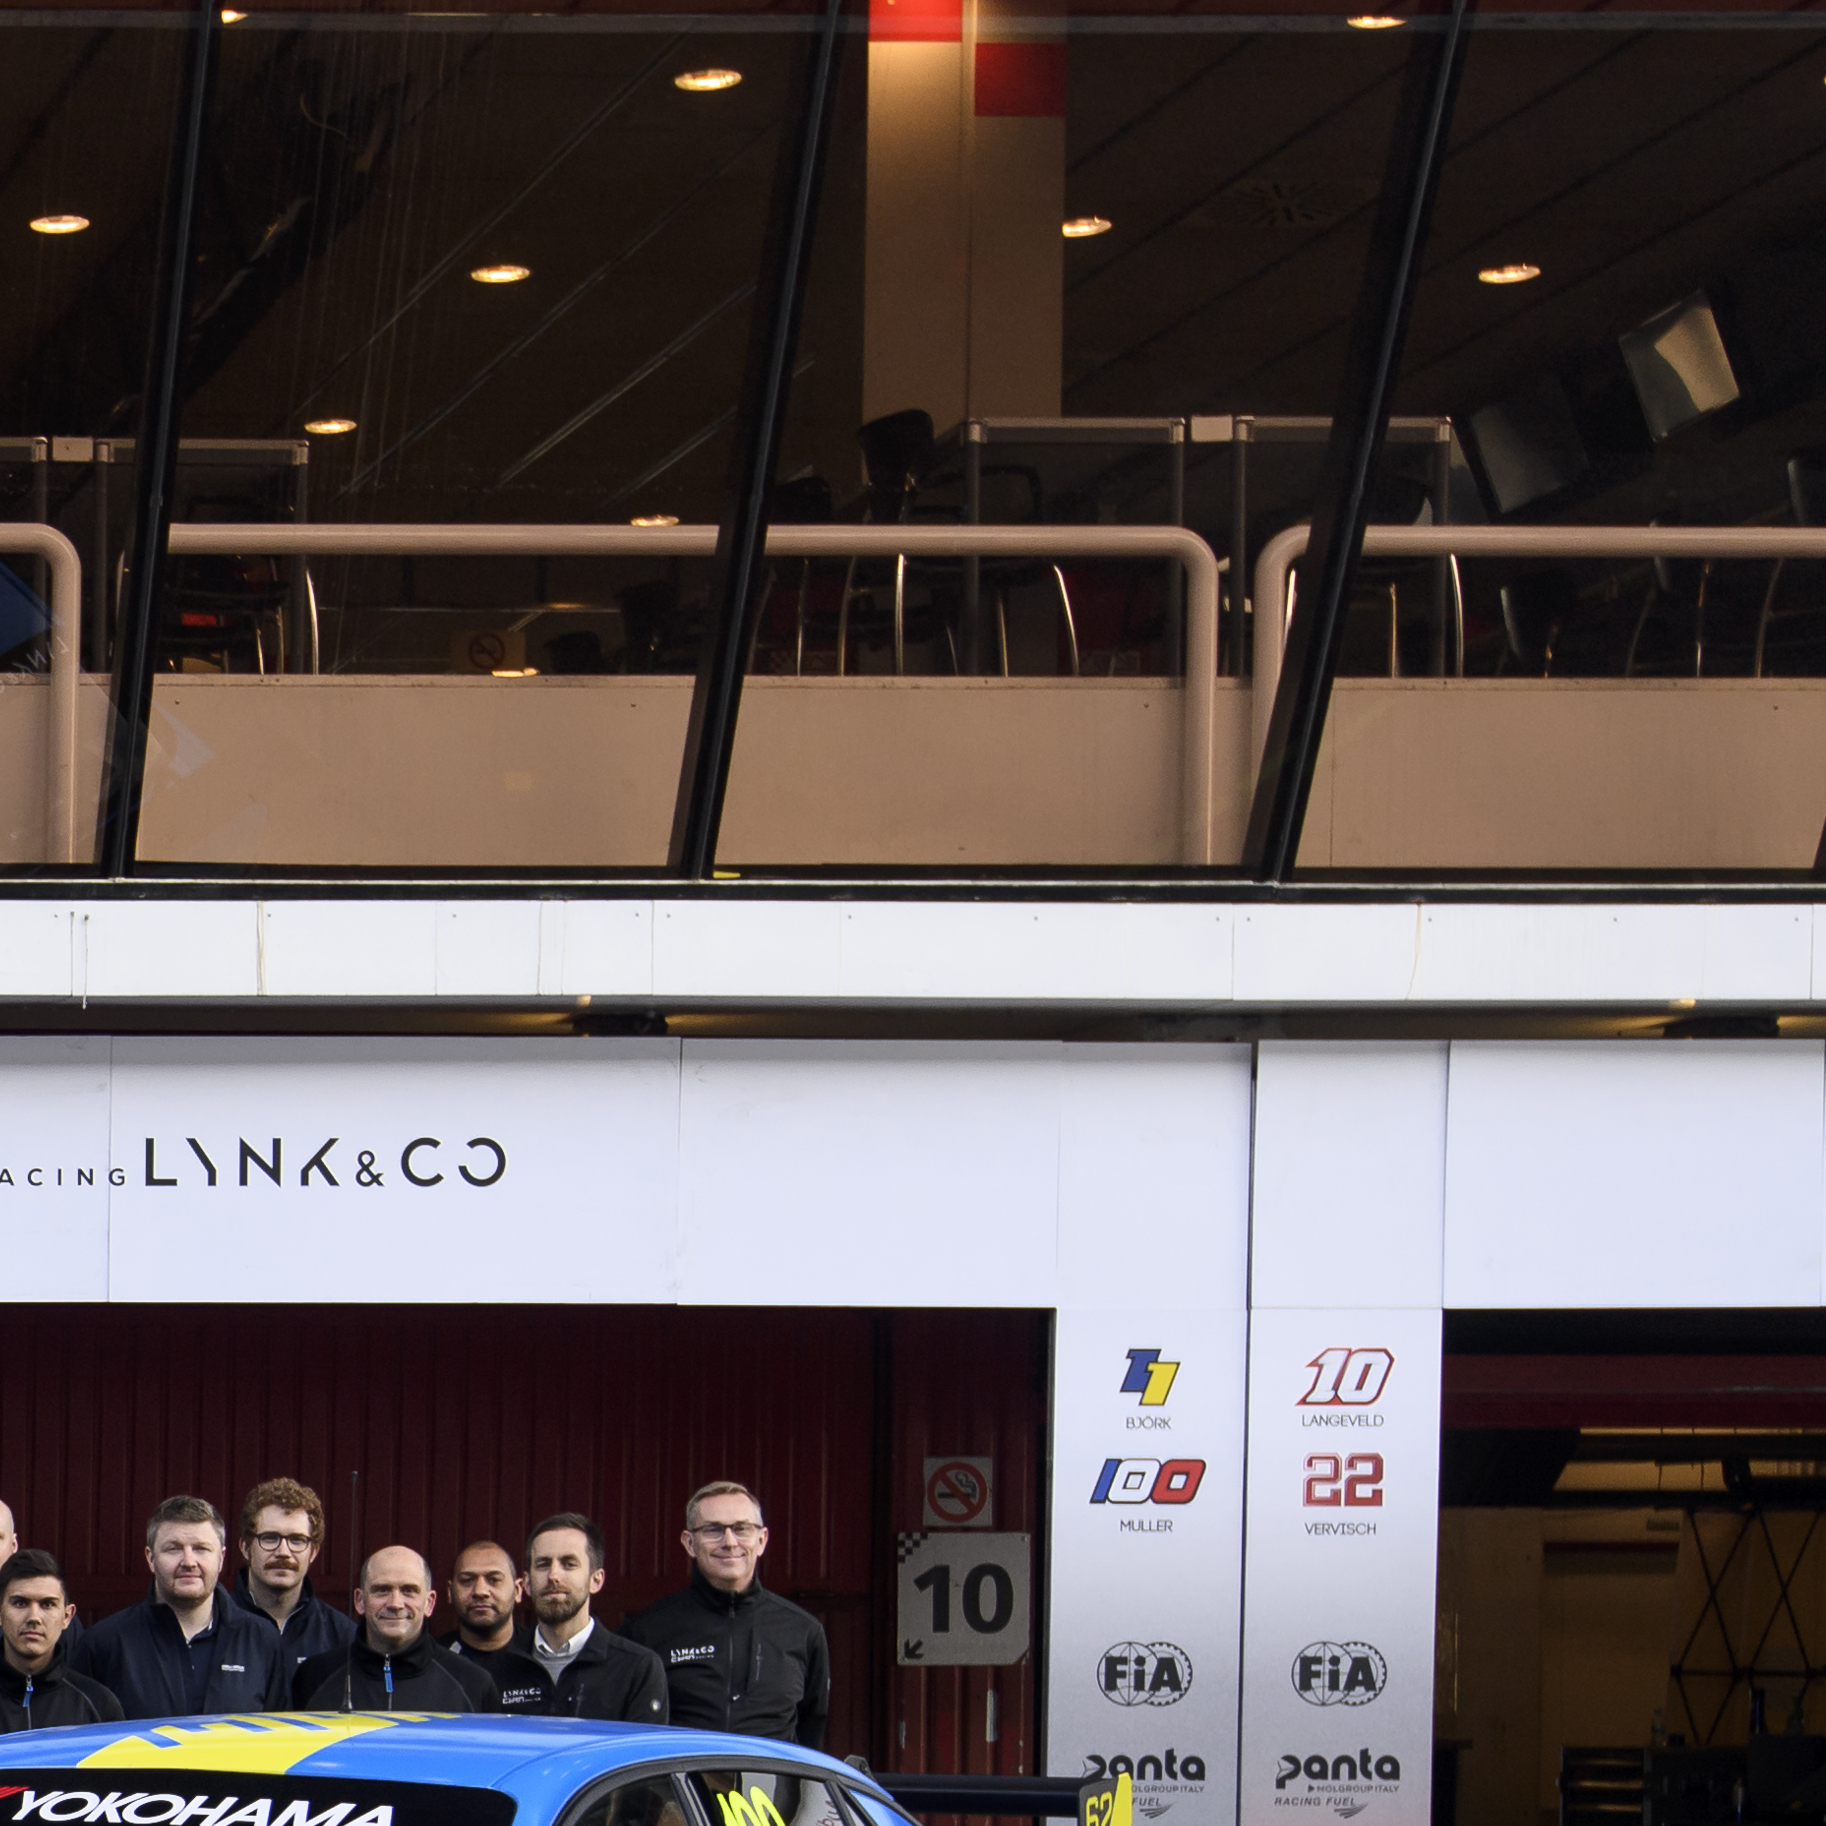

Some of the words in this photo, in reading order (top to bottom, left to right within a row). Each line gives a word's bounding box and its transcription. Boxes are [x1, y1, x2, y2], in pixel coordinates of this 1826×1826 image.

[1120, 1348, 1181, 1406] 11
[1294, 1347, 1395, 1407] 10
[1126, 1415, 1172, 1429] BJÖRK
[1302, 1414, 1384, 1428] LANGEVELD
[1089, 1458, 1207, 1505] 100
[1302, 1452, 1384, 1507] 22
[1120, 1519, 1173, 1533] MULLER
[1305, 1522, 1377, 1535] VERVISCH
[913, 1563, 1014, 1633] 10
[1275, 1748, 1401, 1790] panta
[1132, 1798, 1161, 1807] FUEL
[1274, 1797, 1321, 1807] RACING
[1325, 1797, 1356, 1807] FUEL
